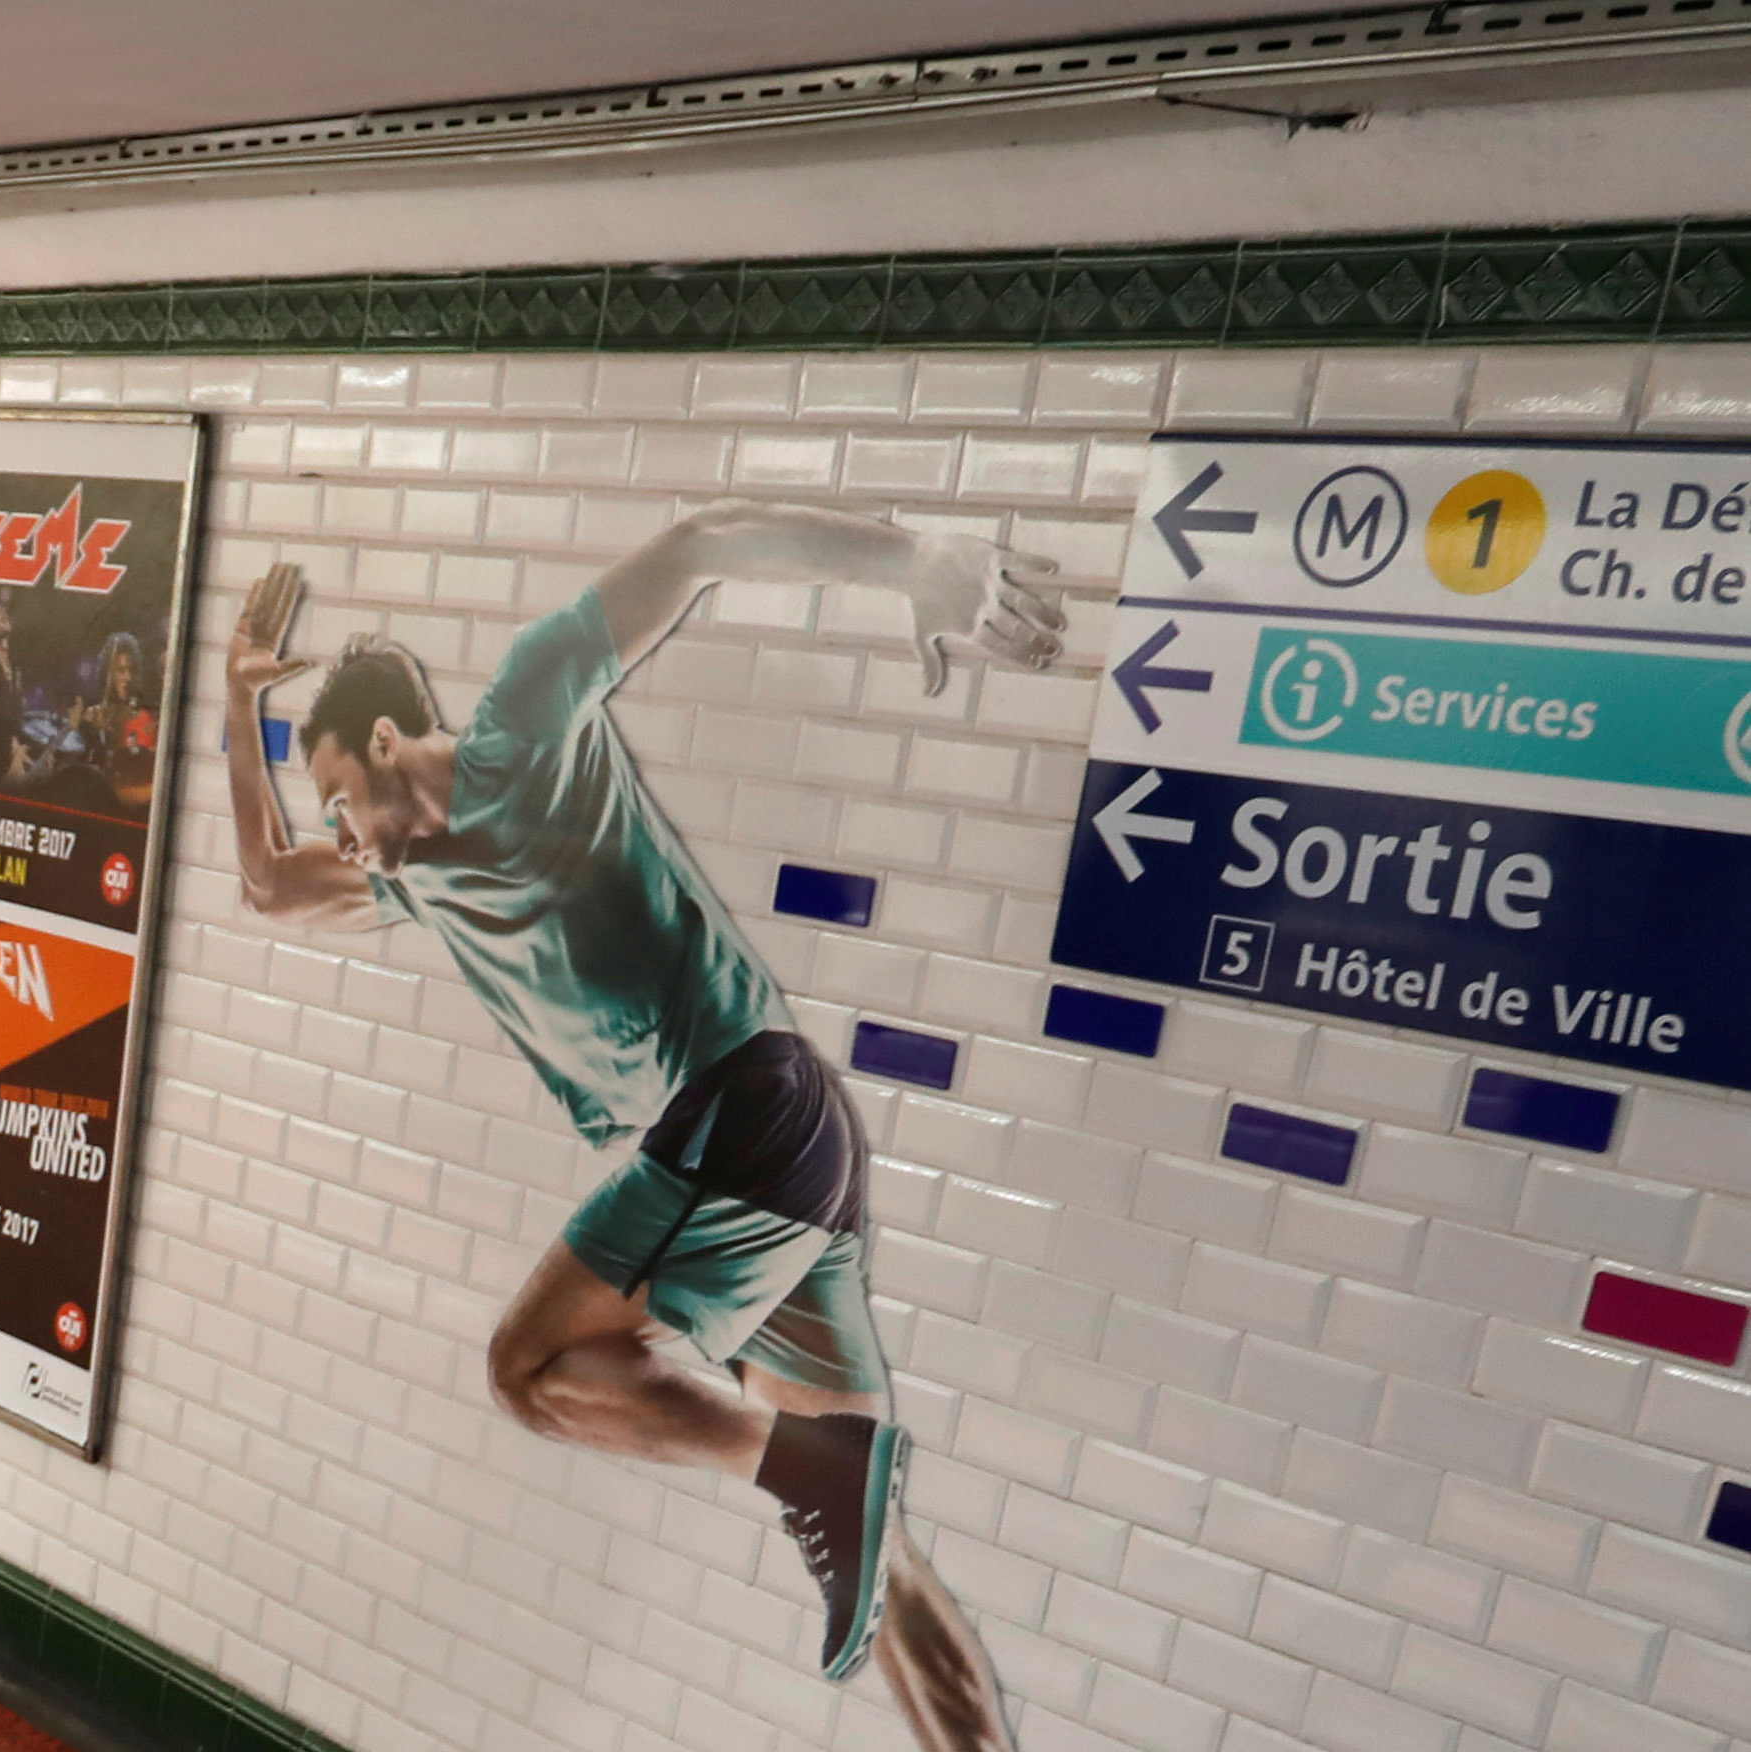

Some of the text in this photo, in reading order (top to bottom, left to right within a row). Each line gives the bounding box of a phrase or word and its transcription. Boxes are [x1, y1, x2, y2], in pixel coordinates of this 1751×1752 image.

[1465, 499, 1503, 569] 1
[1575, 480, 1640, 529] La
[1660, 481, 1751, 533] Dé
[1560, 548, 1746, 605] Ch. de
[1369, 673, 1598, 741] Services
[38, 827, 77, 860] 2017
[1220, 795, 1554, 931] Sortie
[1222, 931, 1685, 1054] 5 Hôtel de Ville
[29, 1134, 107, 1182] UNITED
[2, 1208, 40, 1246] 2017
